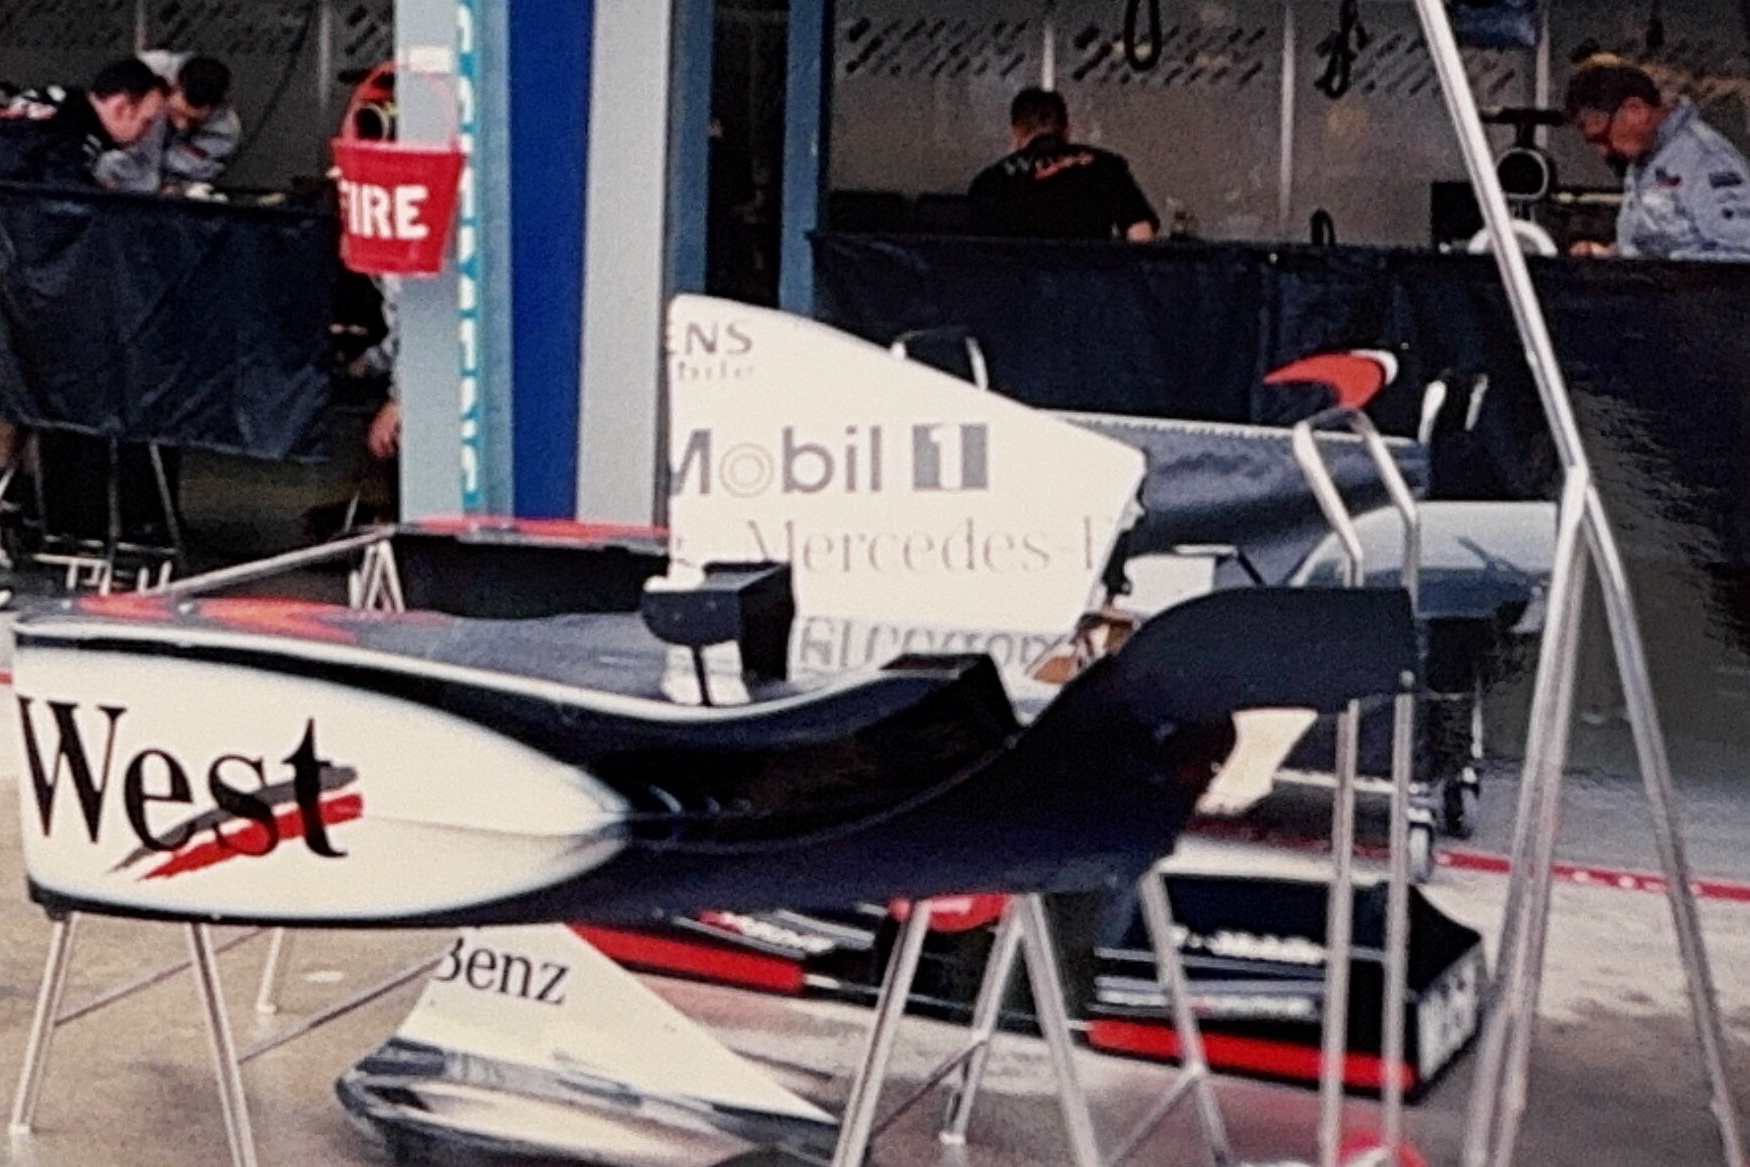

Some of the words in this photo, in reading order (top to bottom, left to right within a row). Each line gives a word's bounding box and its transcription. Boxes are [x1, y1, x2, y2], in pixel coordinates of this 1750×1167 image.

[670, 424, 884, 497] Mobil
[922, 422, 973, 492] 1
[16, 693, 349, 859] West
